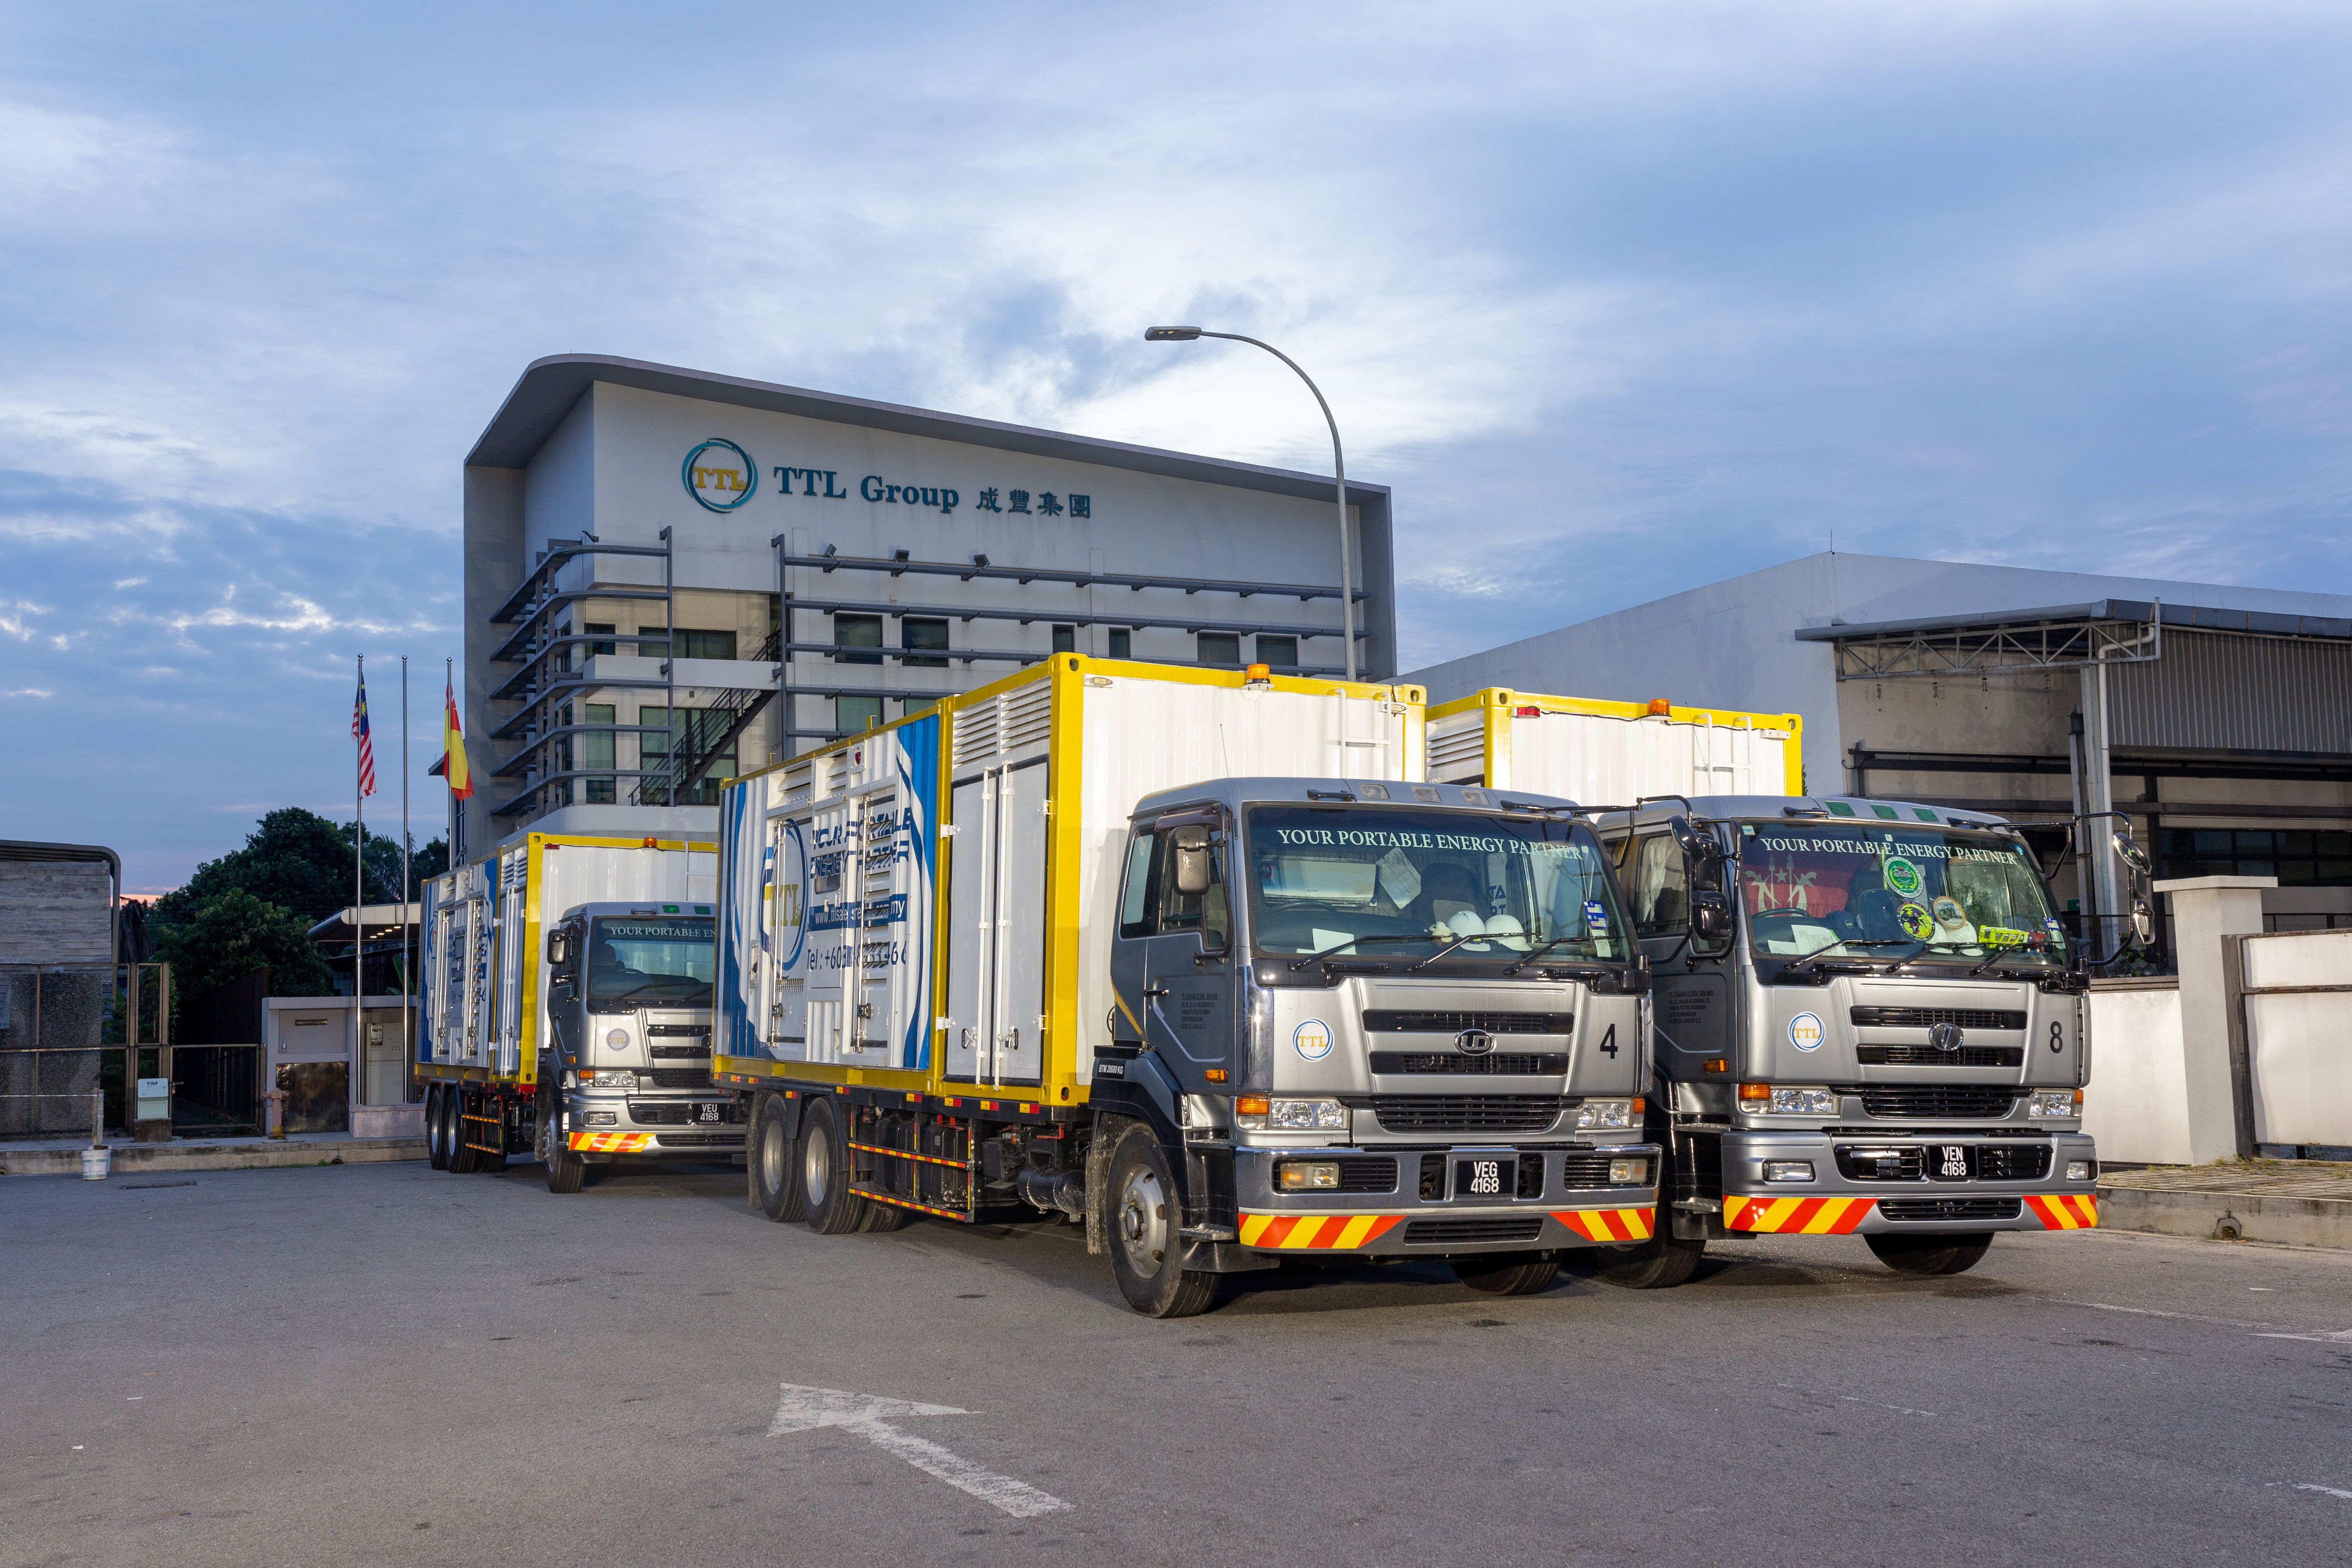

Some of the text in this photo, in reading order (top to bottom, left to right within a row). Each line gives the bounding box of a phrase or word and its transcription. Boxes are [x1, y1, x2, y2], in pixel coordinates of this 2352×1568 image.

[692, 467, 746, 491] TTL
[774, 467, 959, 514] TTL Group
[976, 487, 1090, 519] 成豐集團
[845, 807, 911, 843] PORTALE
[1277, 830, 1583, 860] YOUR PORTABLE ENERGY PARTNER
[1760, 838, 2018, 865] YOUR PORTABLE ENERGY PARTNER
[810, 850, 854, 879] ENERGY
[763, 884, 802, 927] TTL
[610, 927, 642, 935] YOUR
[645, 927, 701, 937] PORTABLE
[1297, 1036, 1328, 1047] TTL
[1600, 1023, 1618, 1059] 4
[1794, 1028, 1819, 1038] TTL
[2050, 1021, 2063, 1054] 8
[1117, 1066, 1123, 1074] KG
[700, 1113, 719, 1121] 4168
[702, 1104, 717, 1112] VEU
[1942, 1146, 1963, 1161] VEN
[1474, 1162, 1498, 1177] VEG
[1942, 1161, 1967, 1176] 4168
[1470, 1177, 1499, 1193] 4168
